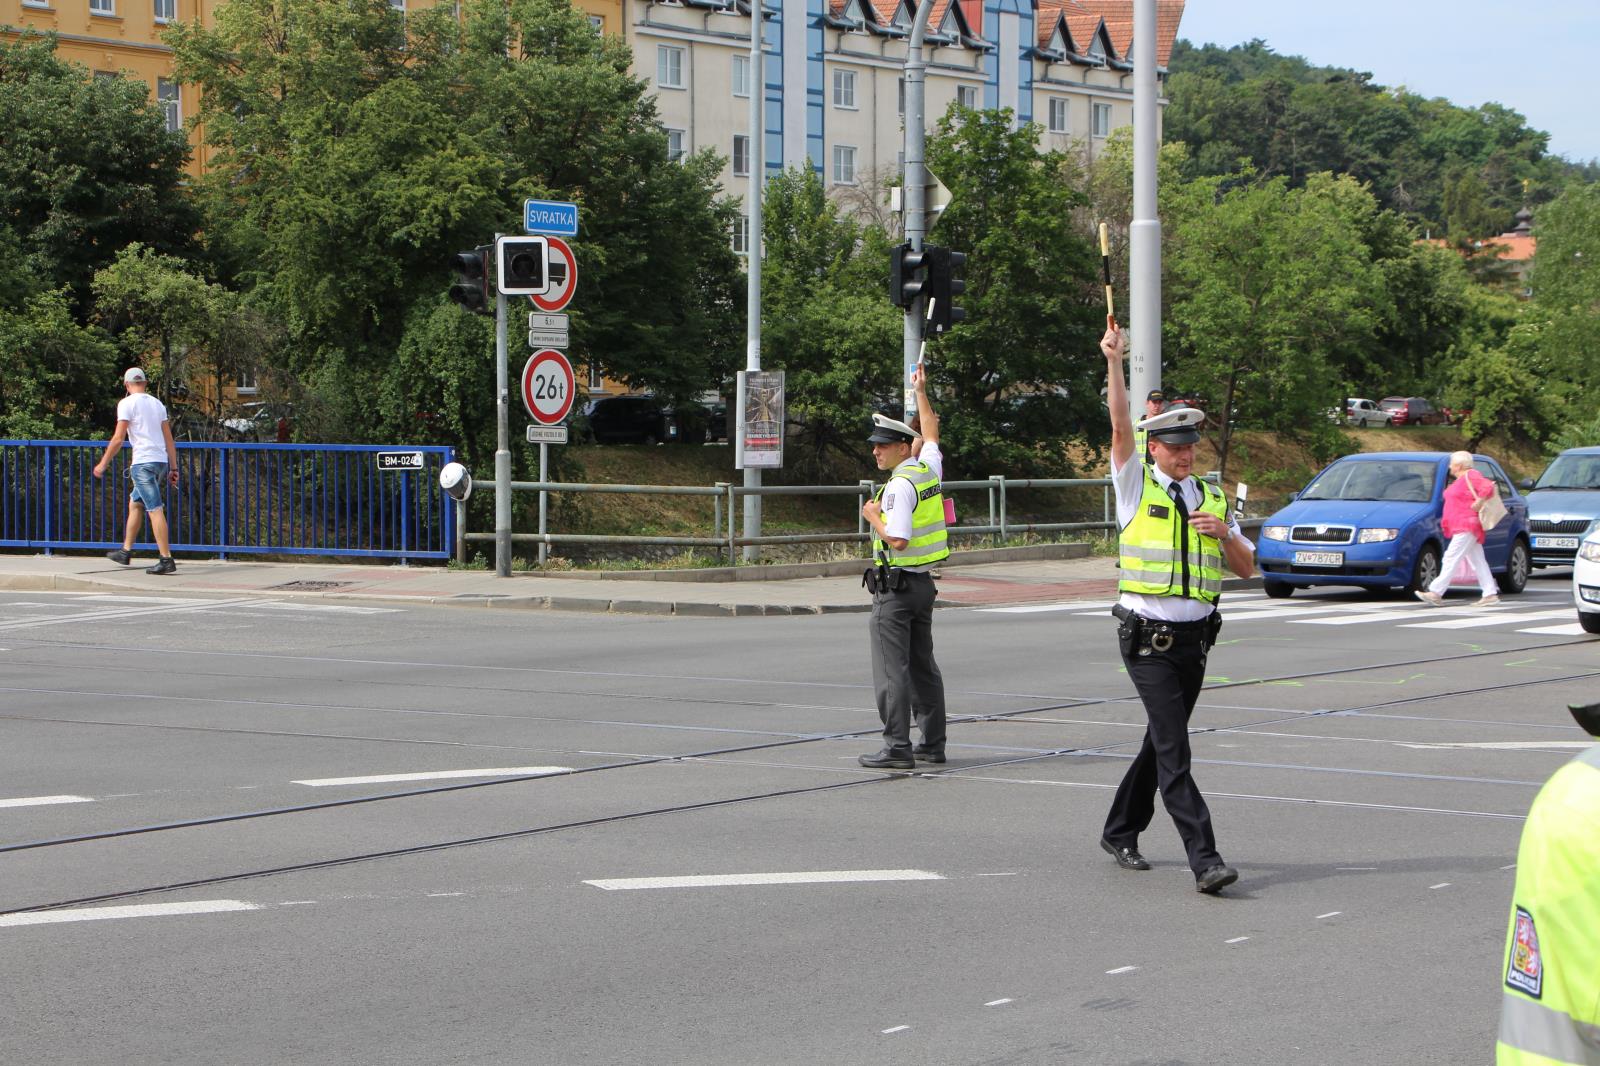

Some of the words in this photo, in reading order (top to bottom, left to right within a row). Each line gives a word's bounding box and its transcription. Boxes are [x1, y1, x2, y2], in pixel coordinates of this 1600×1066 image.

[530, 210, 574, 226] SVRATKA
[384, 456, 416, 466] BM-024
[1556, 539, 1575, 547] 4829
